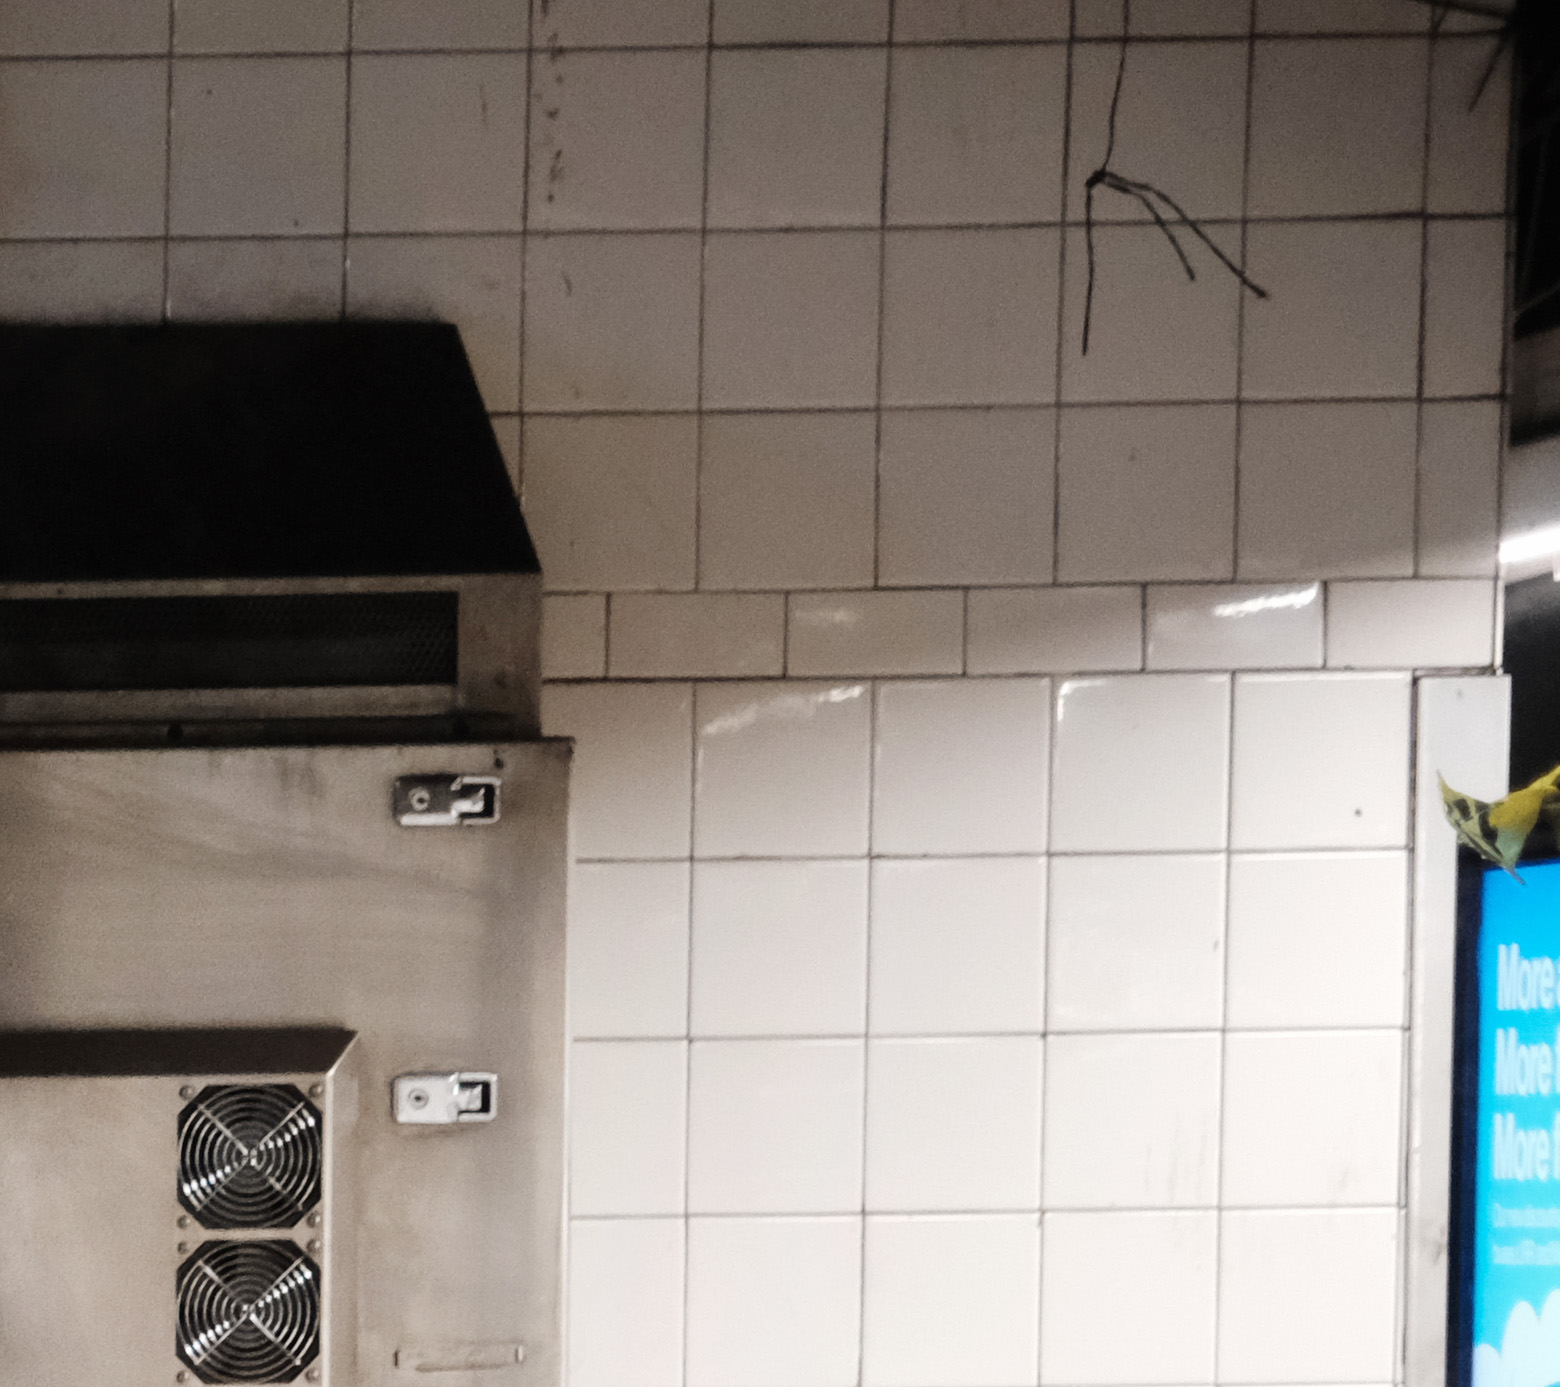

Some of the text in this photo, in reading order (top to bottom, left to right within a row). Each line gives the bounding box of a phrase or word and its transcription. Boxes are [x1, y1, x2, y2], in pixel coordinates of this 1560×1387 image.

[1497, 941, 1555, 1011] More
[1495, 1026, 1553, 1096] More
[1493, 1112, 1551, 1182] More
